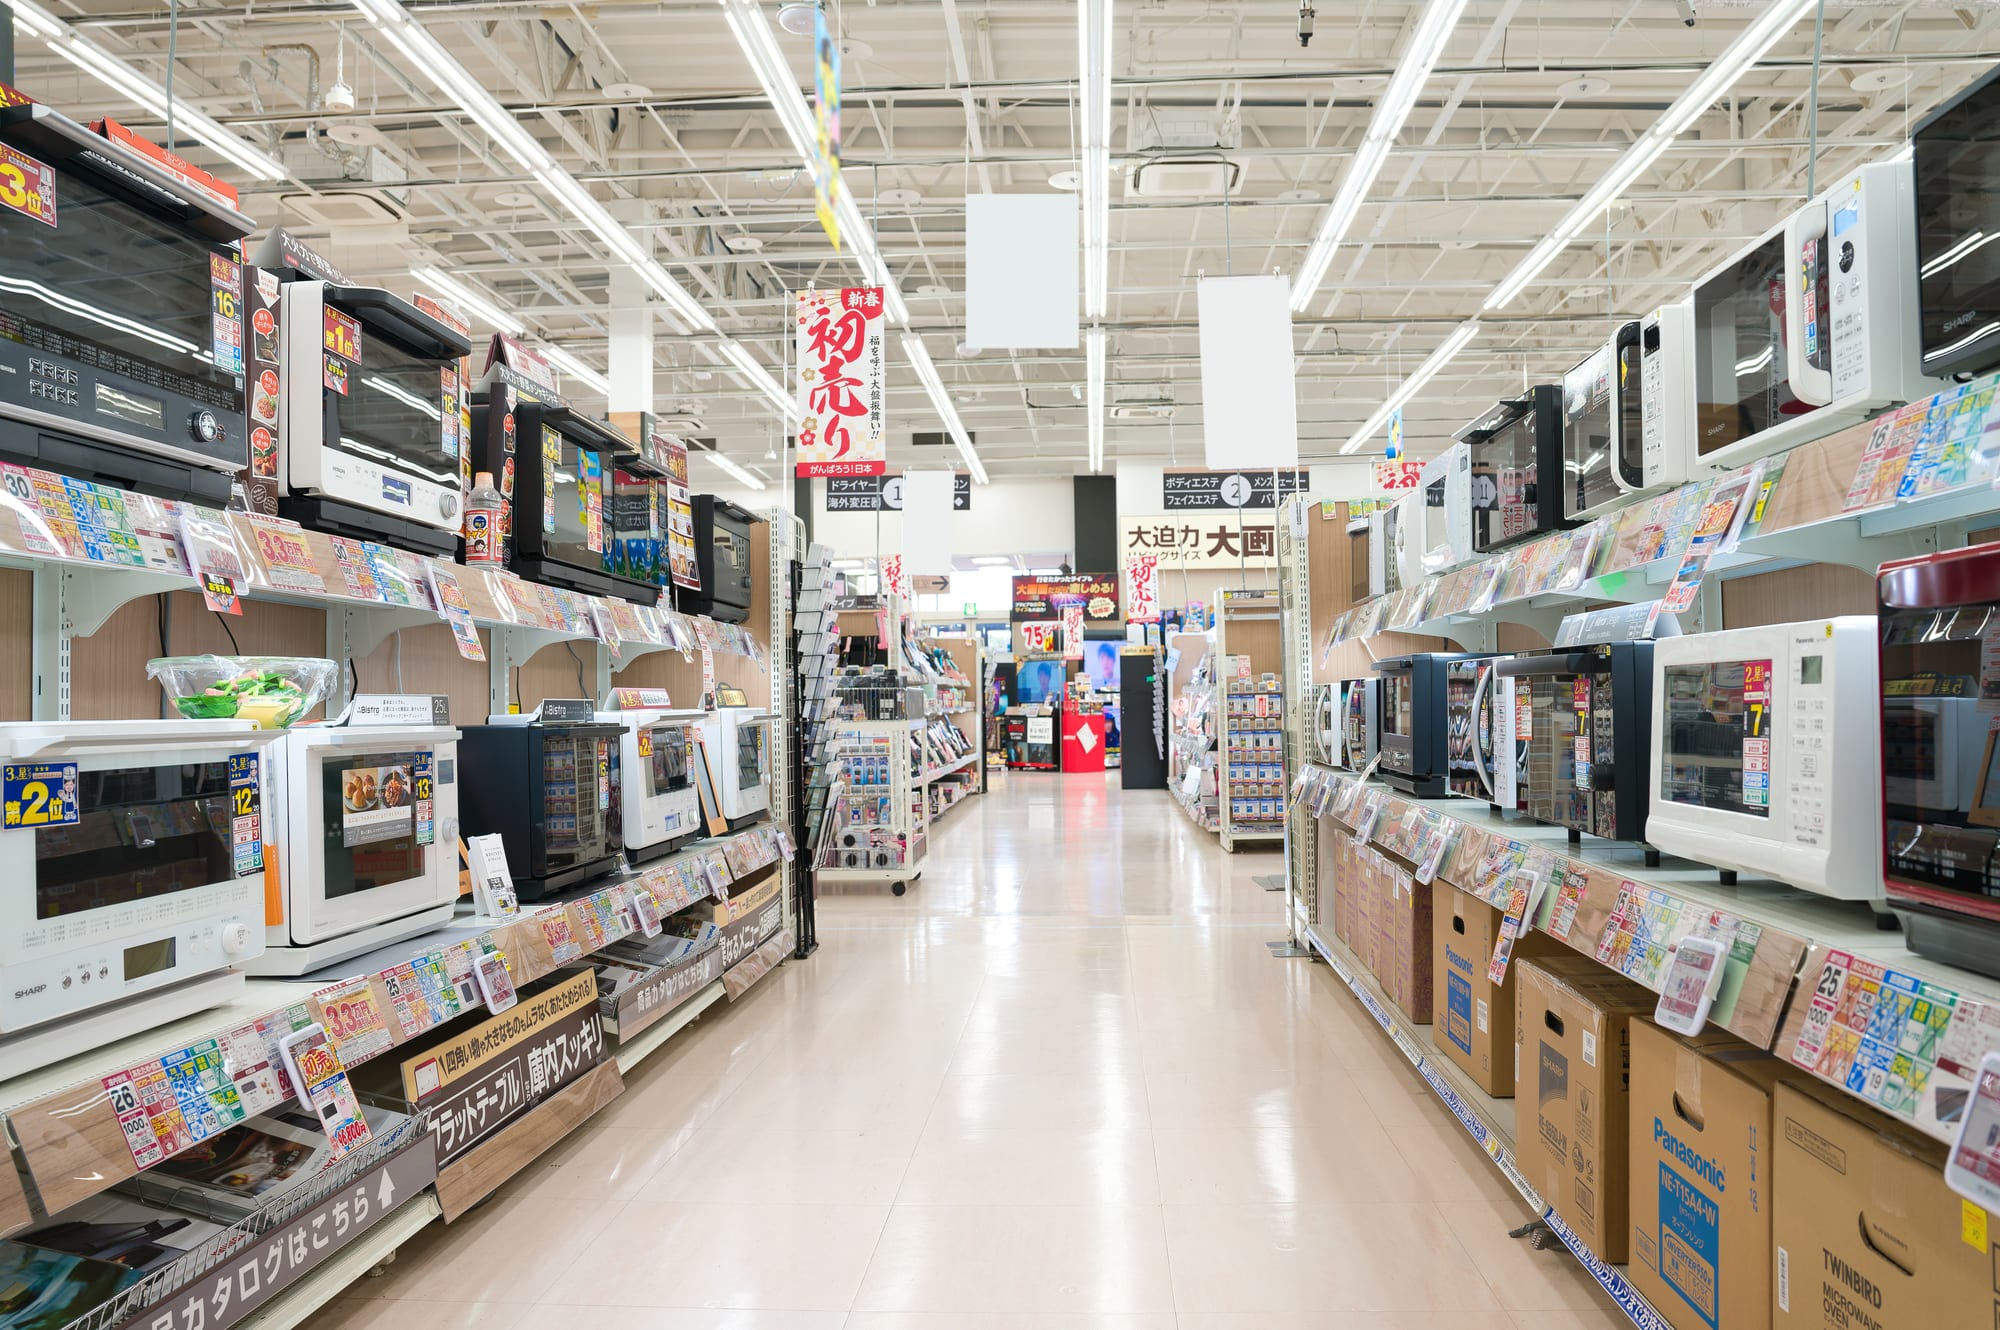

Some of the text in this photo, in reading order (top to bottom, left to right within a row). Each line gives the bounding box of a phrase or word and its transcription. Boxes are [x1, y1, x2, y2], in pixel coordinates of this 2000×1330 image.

[216, 289, 235, 319] 16
[847, 291, 880, 308] 新春
[1942, 310, 1976, 333] SHARP
[806, 306, 869, 461] 初売り
[443, 394, 454, 416] 18
[809, 464, 873, 475] がんばろう!日本
[830, 480, 877, 491] ドライヤー
[1166, 477, 1220, 488] ボディエステ
[1231, 483, 1241, 498] 2
[1254, 477, 1306, 488] メンズェーー
[827, 497, 882, 509] 海外変圧器
[1167, 494, 1219, 505] フェイスエステ
[258, 530, 304, 563] 3.3万円
[1128, 525, 1200, 549] 大迫力
[1130, 563, 1153, 616] 初売り
[1023, 625, 1043, 646] 75
[361, 704, 380, 714] Bistro
[549, 704, 567, 715] Bistro
[1750, 703, 1764, 737] 7
[1577, 710, 1586, 736] 7
[416, 778, 430, 800] 13
[5, 781, 63, 825] 第2位
[235, 787, 253, 816] 12
[1445, 943, 1473, 976] Panasonic
[14, 983, 47, 1000] SHARP
[386, 977, 400, 997] 25
[326, 999, 371, 1039] 3.3万円
[446, 981, 592, 1072] 四角い物や大きなものもムラなくあたためられる
[1542, 1056, 1565, 1079] SHARP
[427, 1069, 521, 1151] フラットテーブル
[527, 1012, 603, 1099] 庫内スッキリ
[1870, 1071, 1882, 1089] 19
[1653, 1115, 1726, 1193] Panasonic
[1661, 1167, 1717, 1228] NE-T15A4-W
[1671, 1215, 1705, 1249] オーブンレンジ
[1822, 1247, 1882, 1310] TWINBIRD
[1822, 1280, 1882, 1330] MICROWAVE
[1823, 1298, 1849, 1328] OVEN
